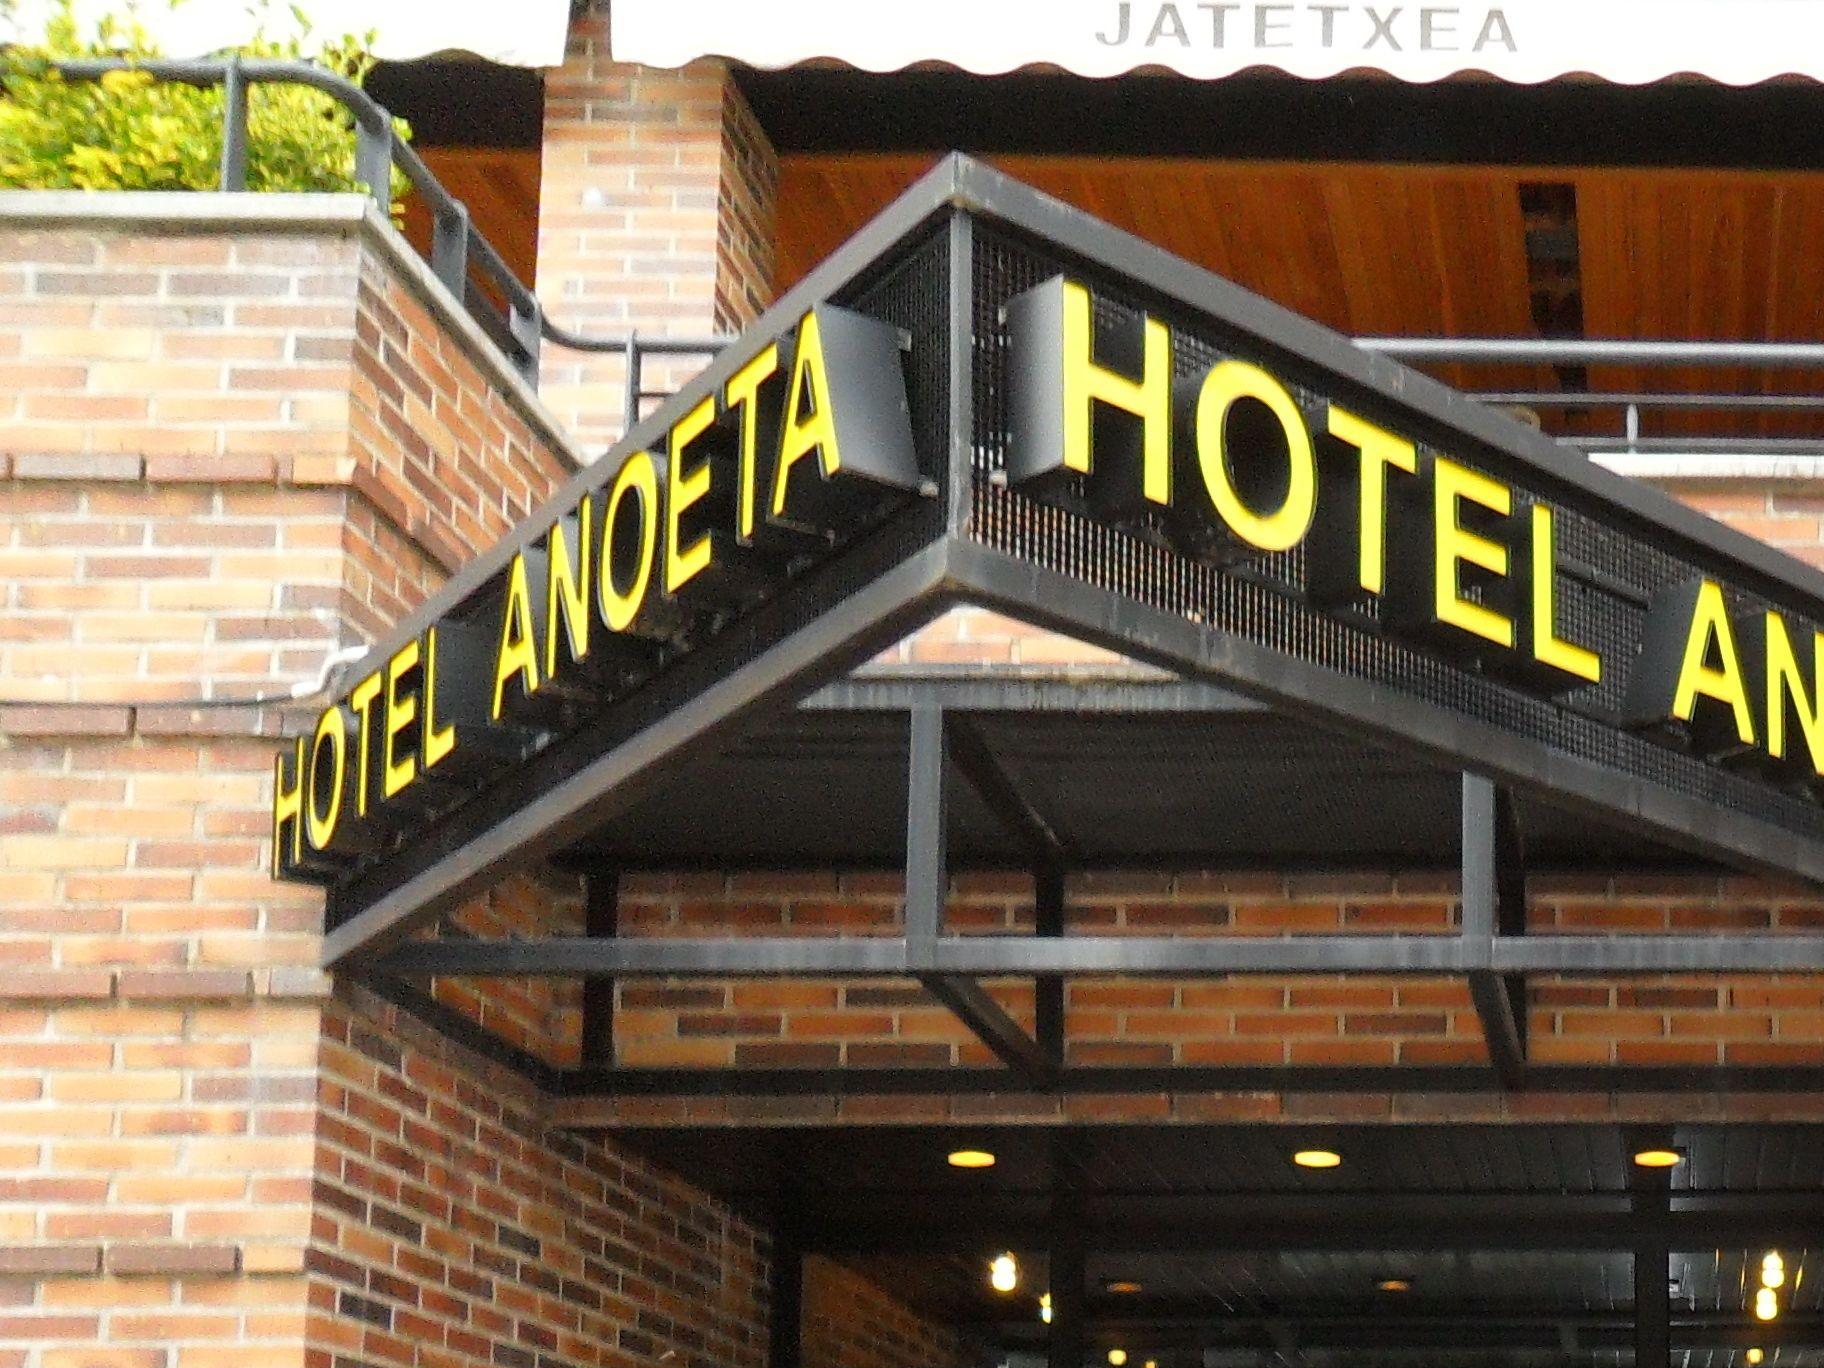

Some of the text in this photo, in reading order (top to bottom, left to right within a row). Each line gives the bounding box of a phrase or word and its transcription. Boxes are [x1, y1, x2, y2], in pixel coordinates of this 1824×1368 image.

[1094, 1, 1518, 52] JATETXEA
[273, 313, 842, 880] HOTEL ANOETA
[1062, 281, 1600, 685] HOTEL
